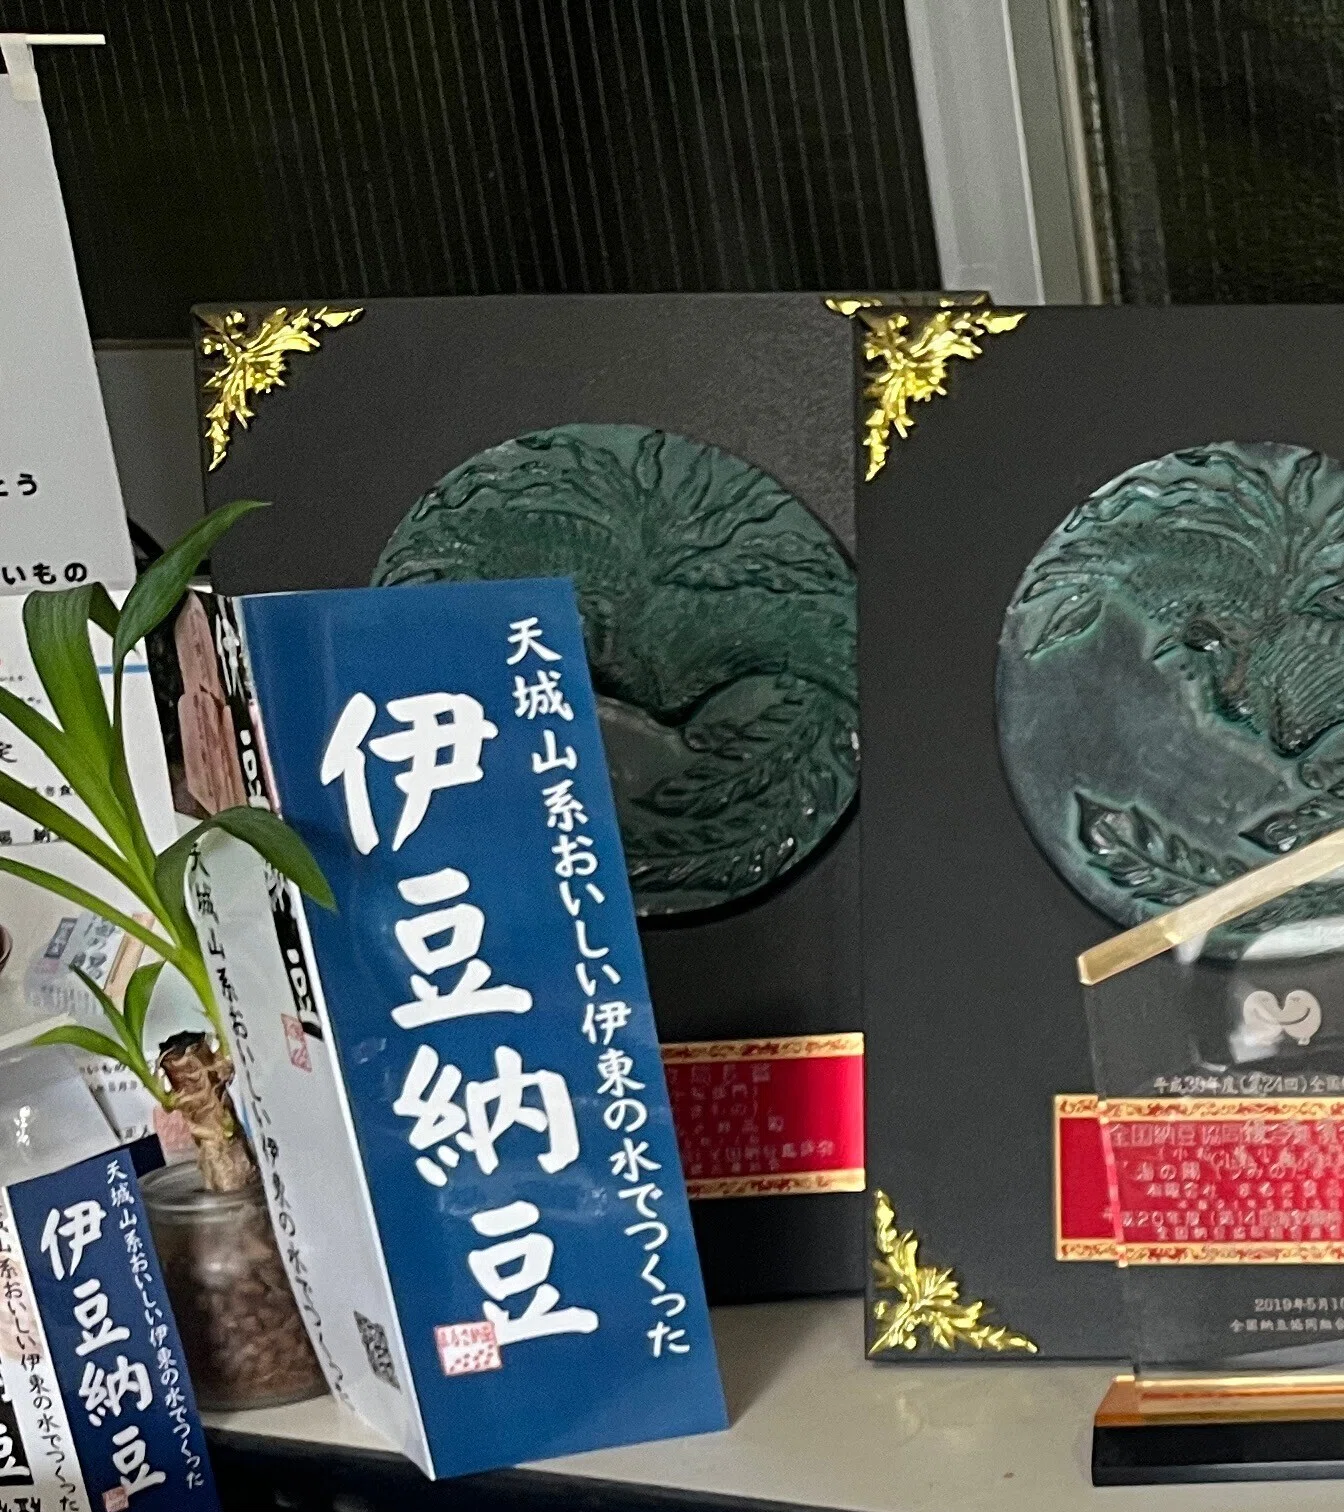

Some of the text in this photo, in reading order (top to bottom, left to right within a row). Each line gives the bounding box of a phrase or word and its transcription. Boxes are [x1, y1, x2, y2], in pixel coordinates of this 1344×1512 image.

[320, 691, 599, 1346] 伊豆納豆
[506, 616, 690, 1358] 天城山系おいしい伊東の水でつくった
[41, 1199, 167, 1495] 伊豆納豆
[105, 1159, 205, 1490] 天城山系おいしい伊東の水でつくった
